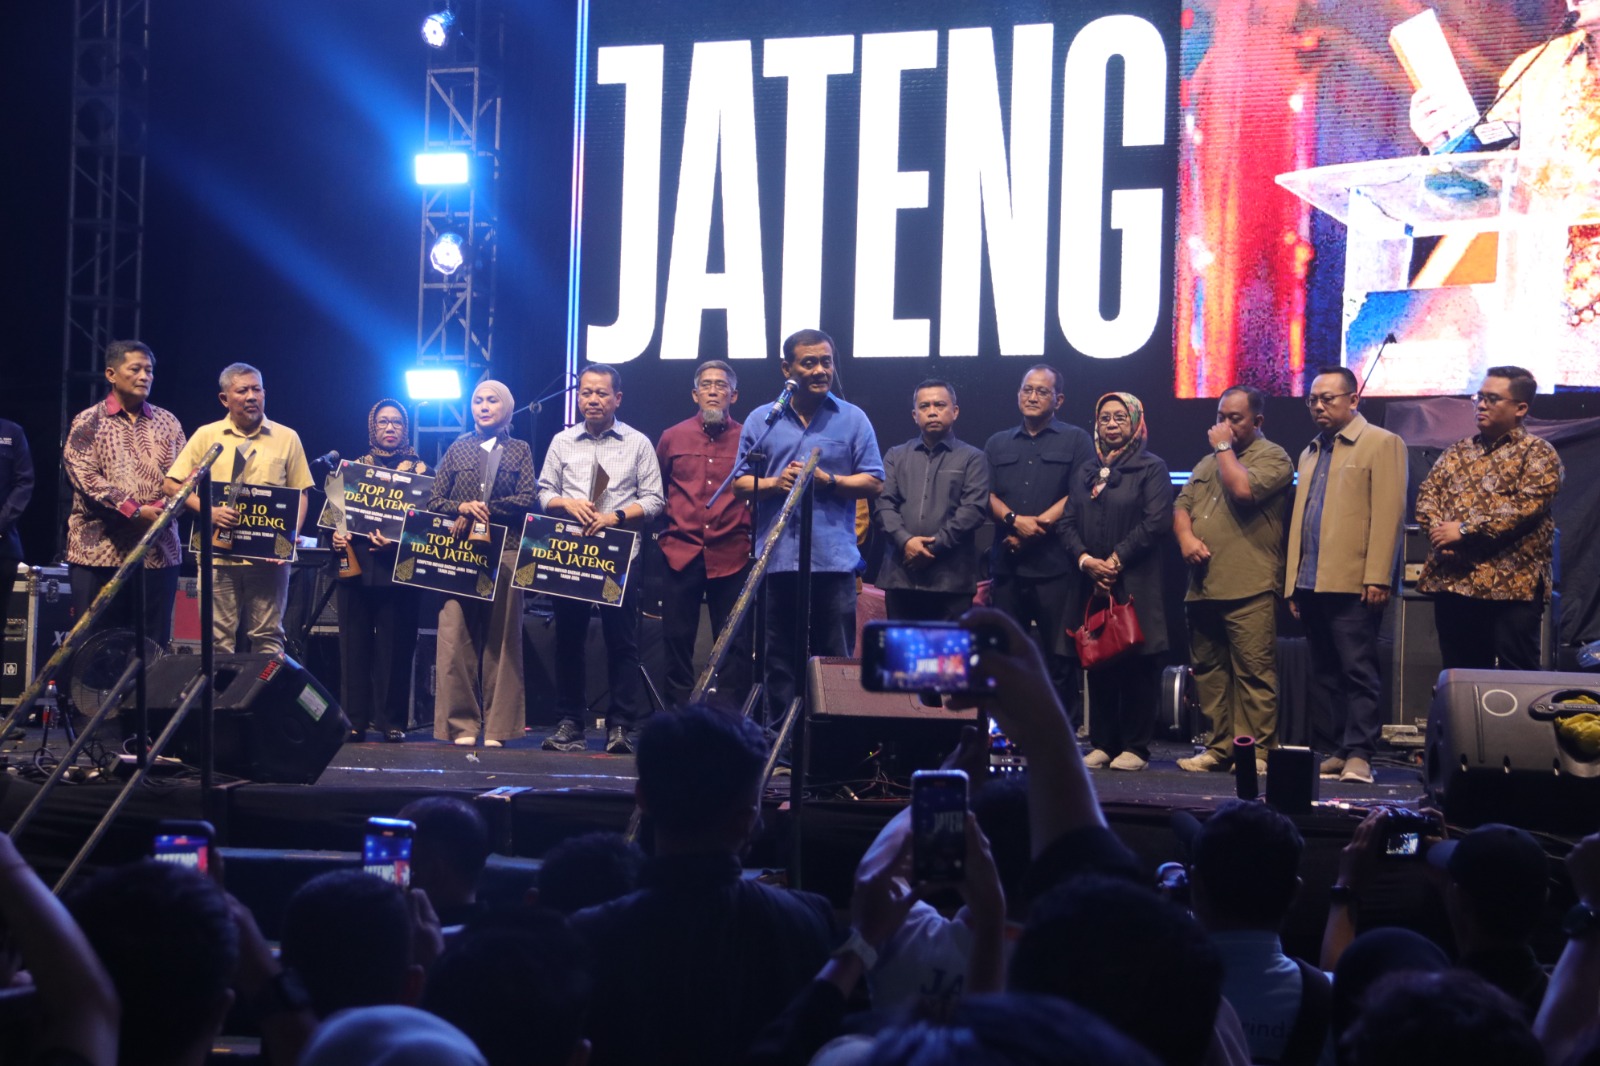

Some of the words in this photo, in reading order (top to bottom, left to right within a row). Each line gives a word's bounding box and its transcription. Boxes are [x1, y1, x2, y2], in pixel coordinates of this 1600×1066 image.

[586, 14, 1168, 364] JATENG
[344, 490, 370, 507] DEA
[358, 482, 386, 496] TOP
[388, 488, 404, 500] 10
[252, 504, 268, 515] 10
[427, 532, 455, 547] TOP
[548, 537, 579, 553] TOP
[583, 544, 599, 556] 10
[410, 541, 441, 560] IDEA
[443, 548, 489, 568] JATENG
[531, 547, 564, 565] IDEA
[566, 553, 617, 574] JATENG
